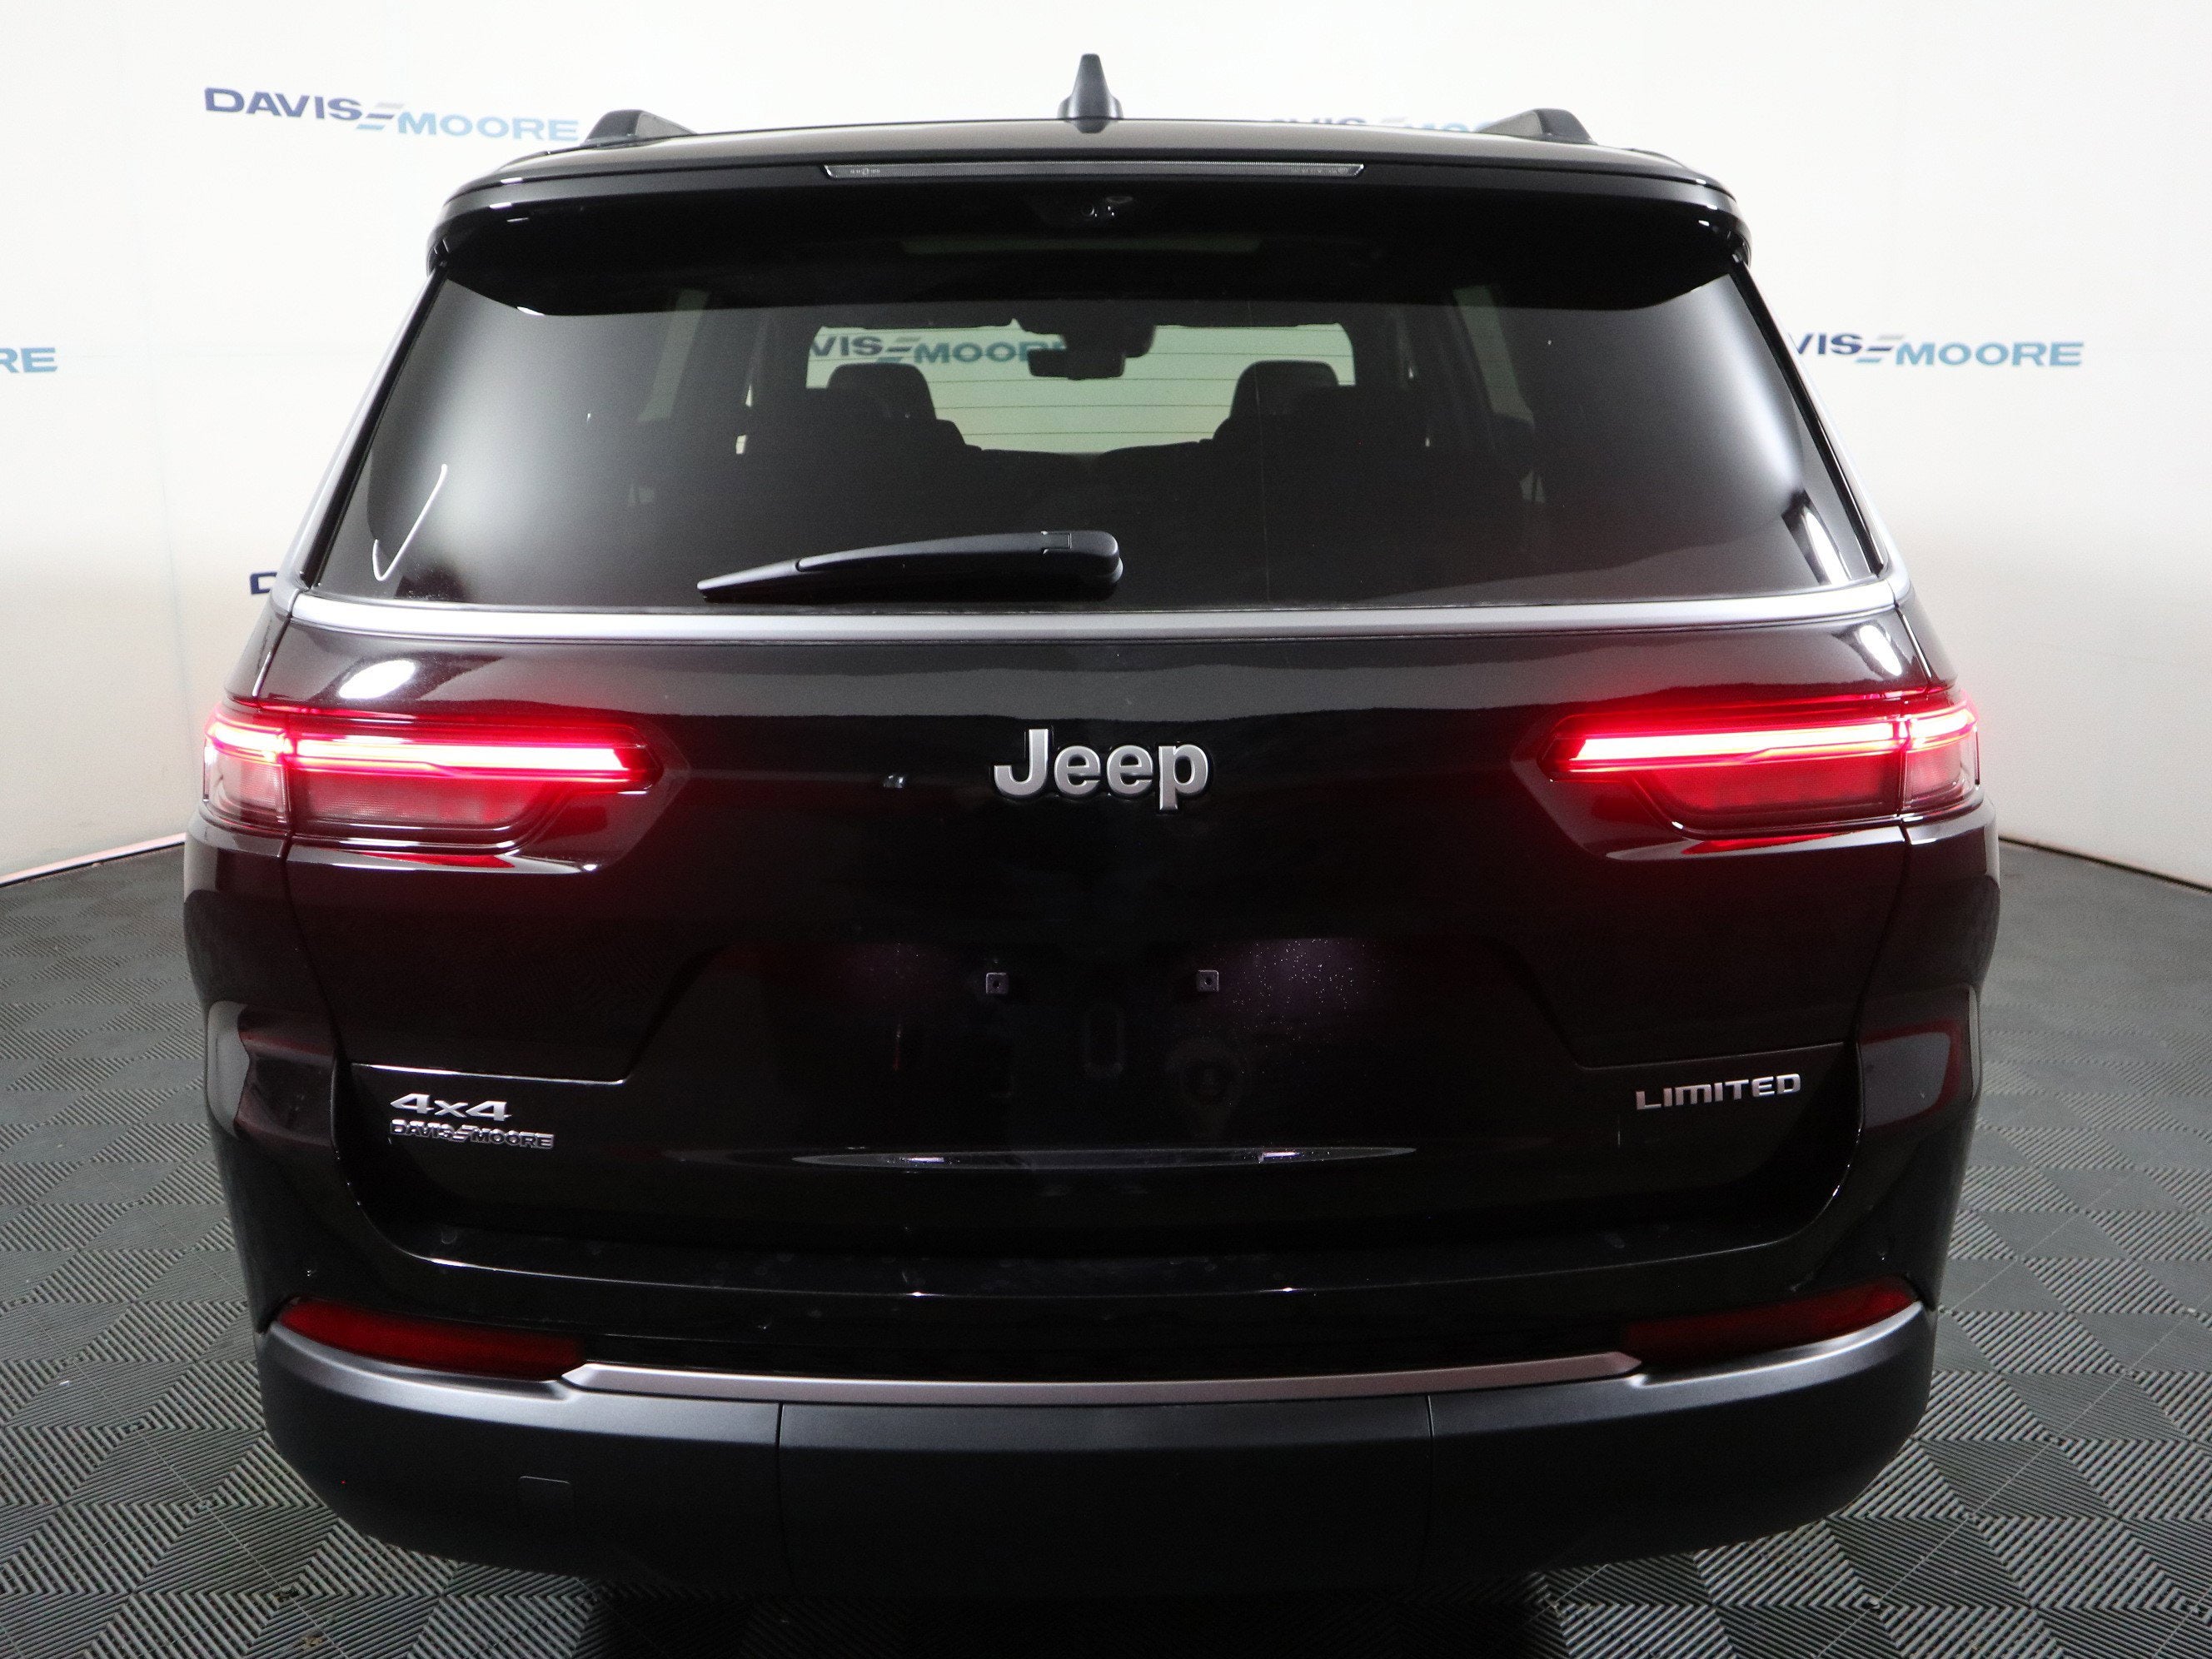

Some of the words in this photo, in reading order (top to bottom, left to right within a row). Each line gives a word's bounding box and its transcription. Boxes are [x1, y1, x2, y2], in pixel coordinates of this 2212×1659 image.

[204, 87, 361, 121] DAVIS
[397, 111, 579, 142] MOORE
[1895, 341, 2084, 366] MOORE
[994, 728, 1208, 810] Jeep
[390, 1093, 512, 1121] 4x4
[1635, 1073, 1801, 1110] LIMITED
[390, 1118, 456, 1140] DAVIS
[470, 1128, 555, 1148] MOORE
